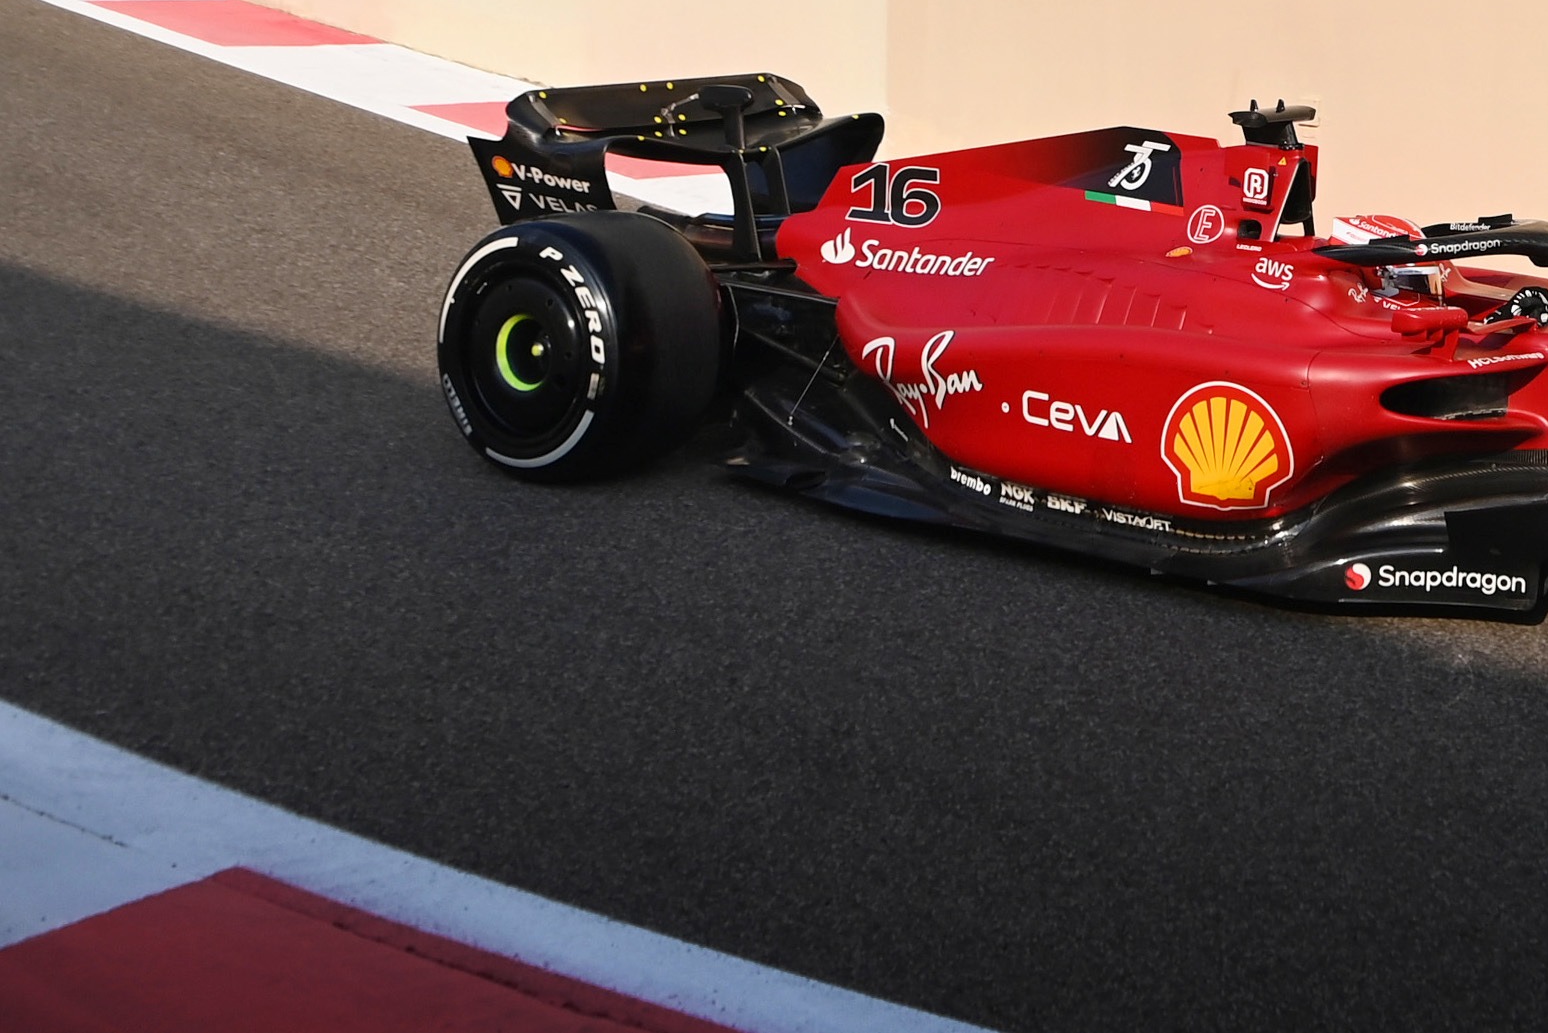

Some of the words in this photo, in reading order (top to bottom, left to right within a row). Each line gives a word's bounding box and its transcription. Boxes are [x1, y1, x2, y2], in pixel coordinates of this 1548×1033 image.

[511, 162, 591, 193] V-Power
[847, 162, 942, 228] 16
[854, 239, 995, 277] Santander
[1430, 238, 1501, 255] Snapdragon
[1255, 257, 1295, 281] aws
[538, 245, 564, 261] P
[560, 264, 606, 365] ZERO
[950, 467, 992, 496] brembo
[1000, 481, 1035, 505] NGK
[1377, 564, 1527, 596] Snapdragon
